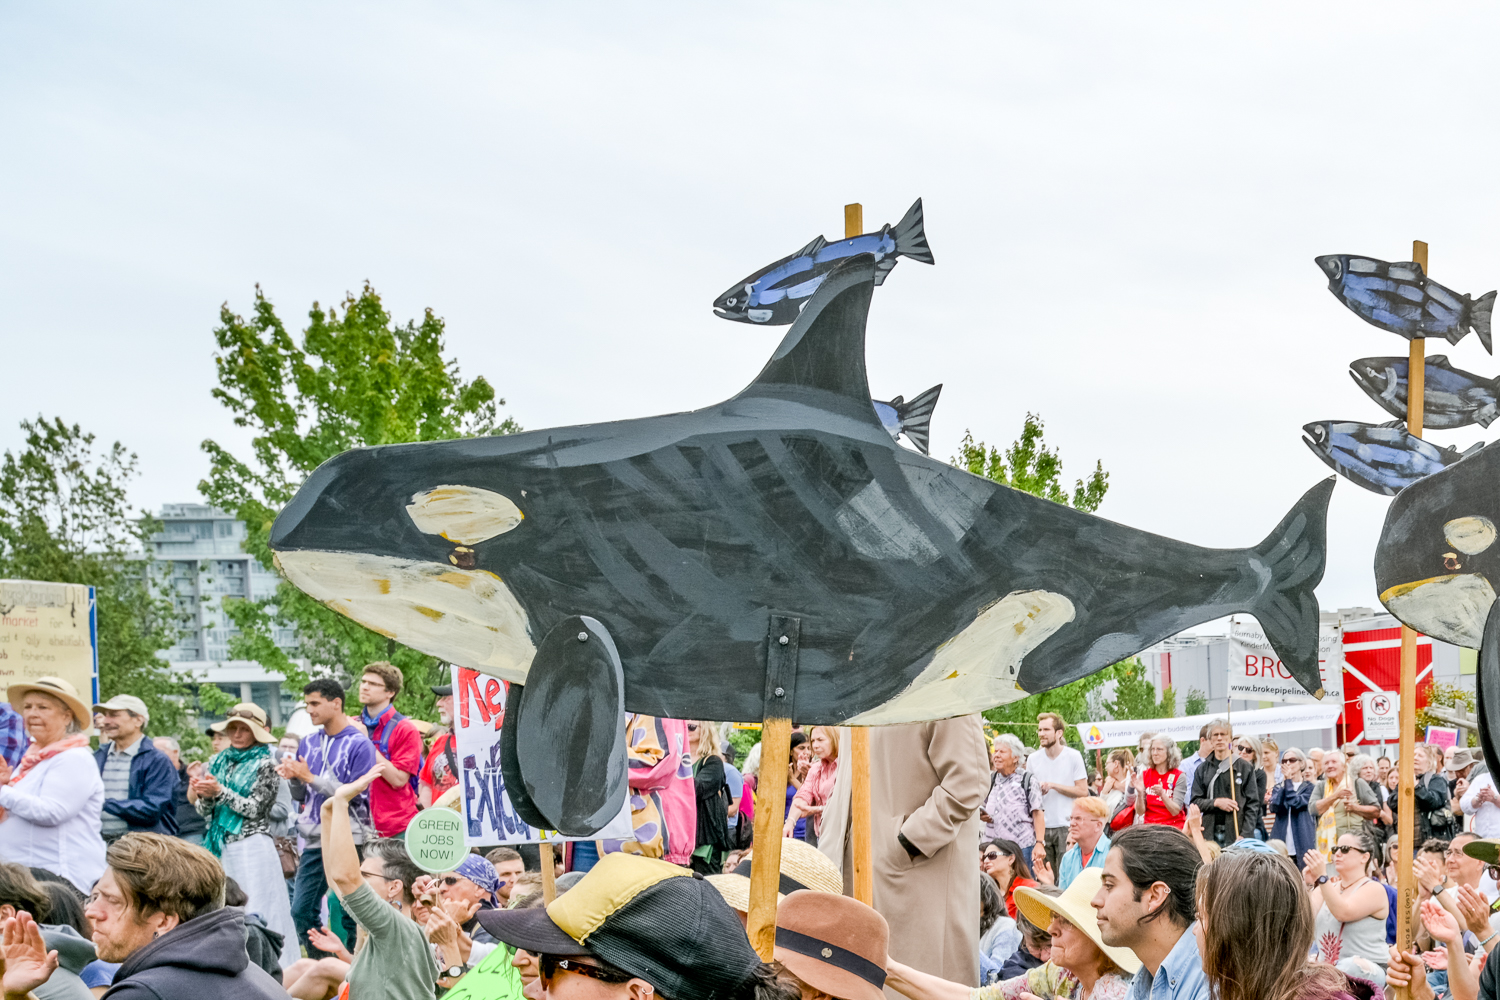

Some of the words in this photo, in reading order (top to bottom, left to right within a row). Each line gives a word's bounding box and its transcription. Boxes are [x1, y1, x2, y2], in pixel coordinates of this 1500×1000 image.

[2, 616, 38, 627] market
[1240, 640, 1273, 651] KinderMo
[1245, 654, 1327, 680] BROE
[1231, 684, 1340, 697] www.brokepipelineh.ca
[1107, 729, 1132, 738] triratna
[418, 819, 460, 831] GREEN
[422, 834, 454, 846] JOBS
[420, 849, 454, 861] NOW!
